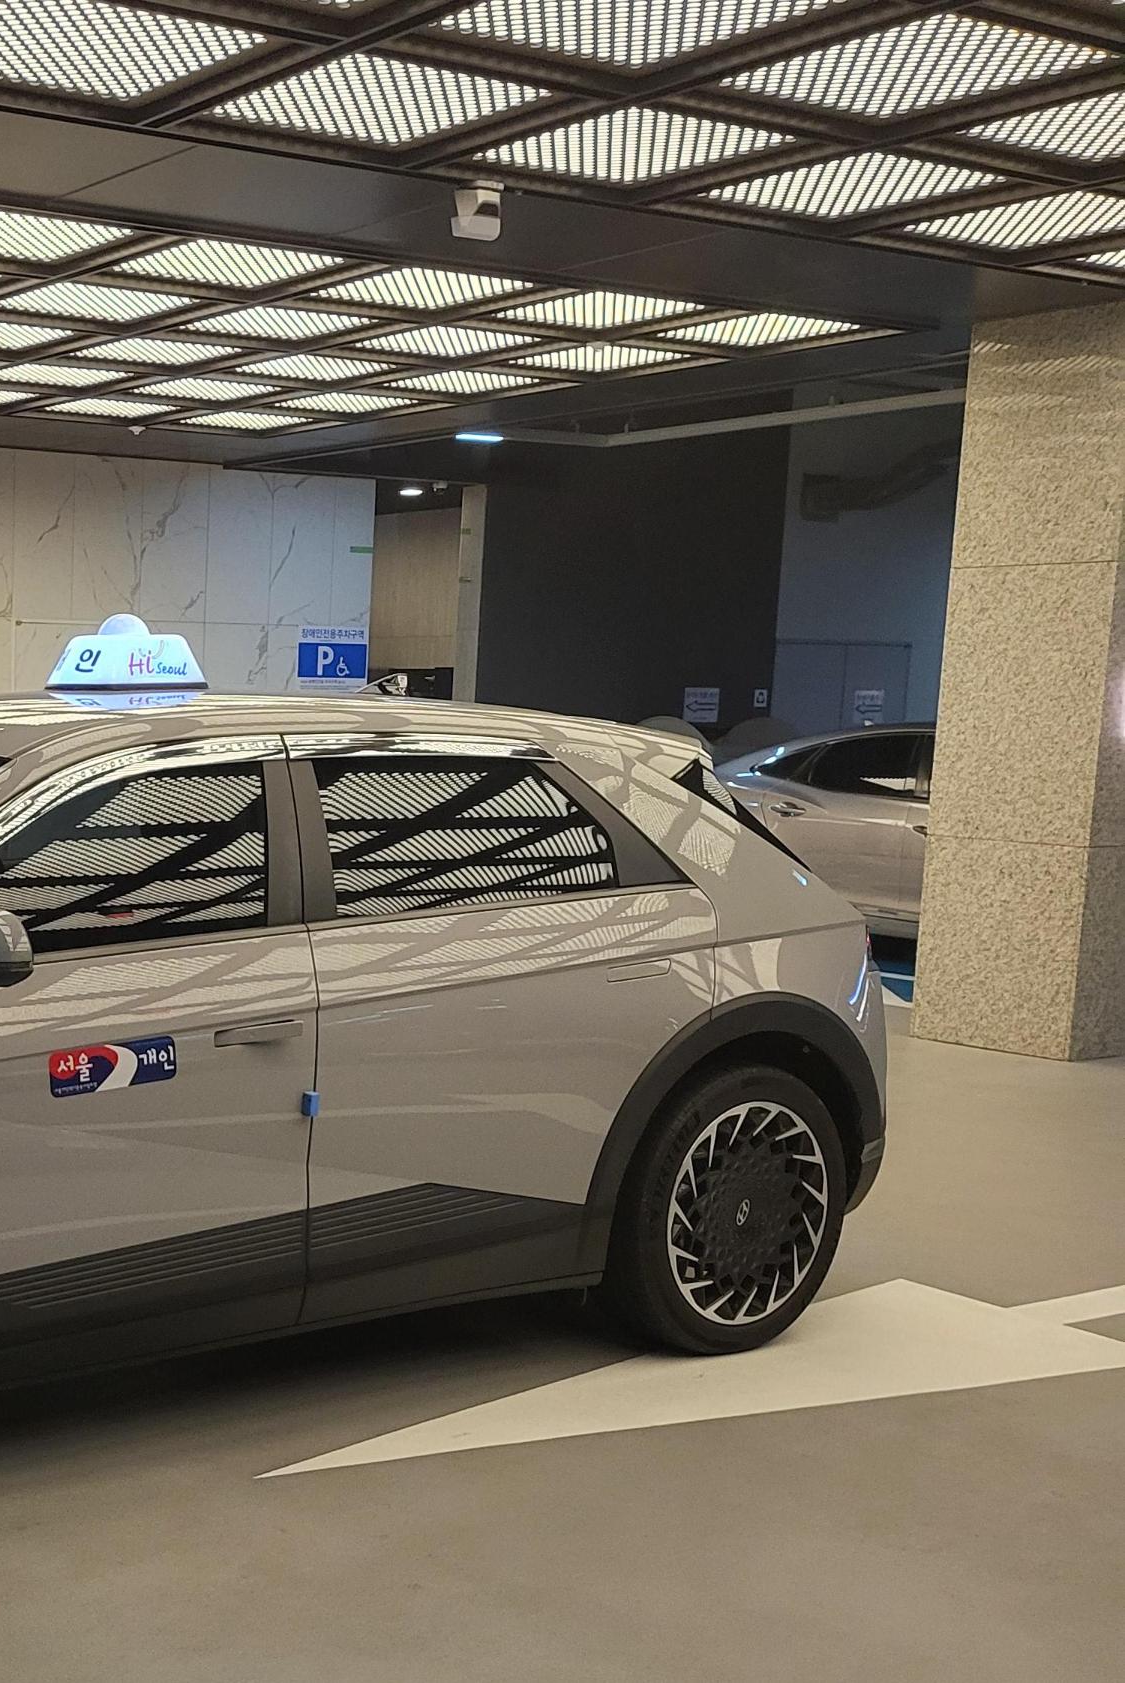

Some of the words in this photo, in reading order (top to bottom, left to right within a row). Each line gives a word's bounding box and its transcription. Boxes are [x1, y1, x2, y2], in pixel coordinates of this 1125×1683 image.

[301, 628, 365, 640] 장애인전용주차구역
[127, 649, 155, 677] Hi
[155, 661, 188, 677] Seoul
[316, 645, 335, 676] P
[57, 1052, 94, 1083] 서울
[138, 1044, 175, 1071] 개인
